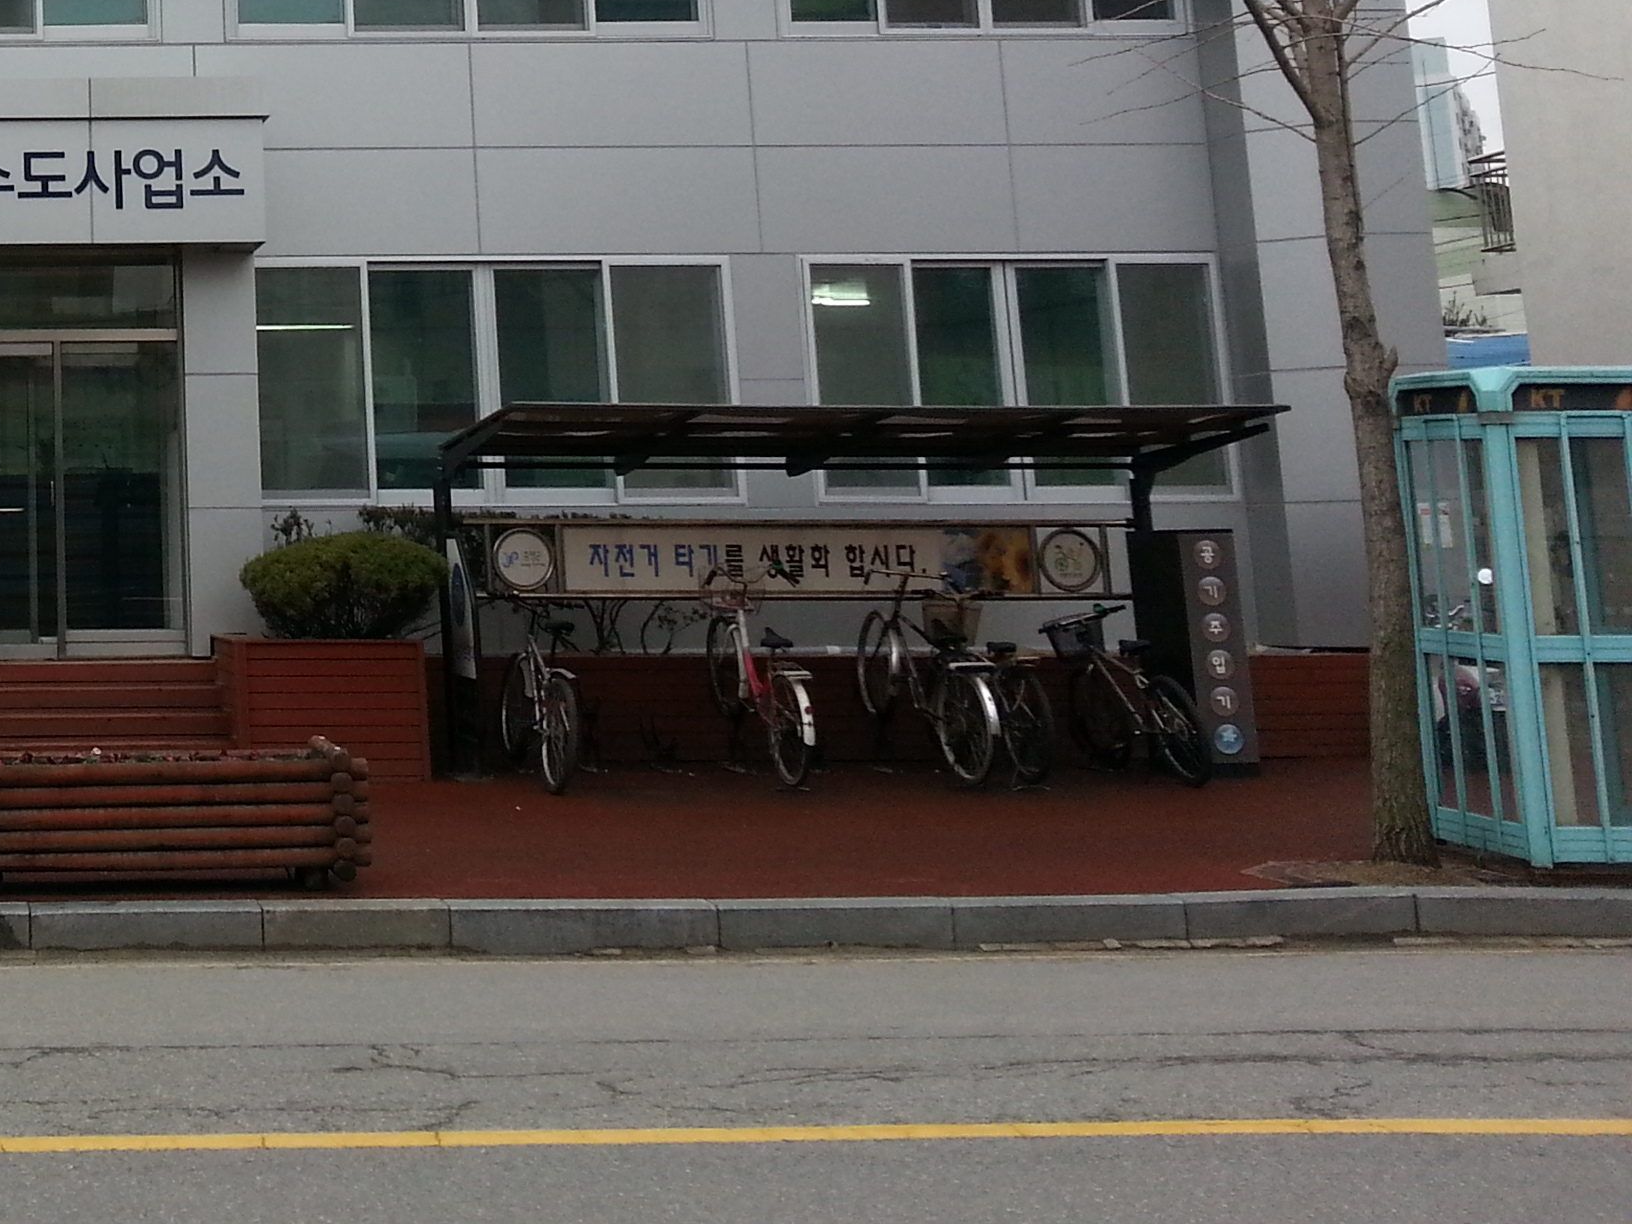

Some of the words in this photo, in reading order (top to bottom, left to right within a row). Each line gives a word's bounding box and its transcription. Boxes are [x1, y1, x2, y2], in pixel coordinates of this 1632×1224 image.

[1530, 388, 1565, 409] KT
[589, 543, 660, 578] 자전거
[674, 543, 744, 578] 타기를
[1200, 545, 1232, 710] 공기주입기
